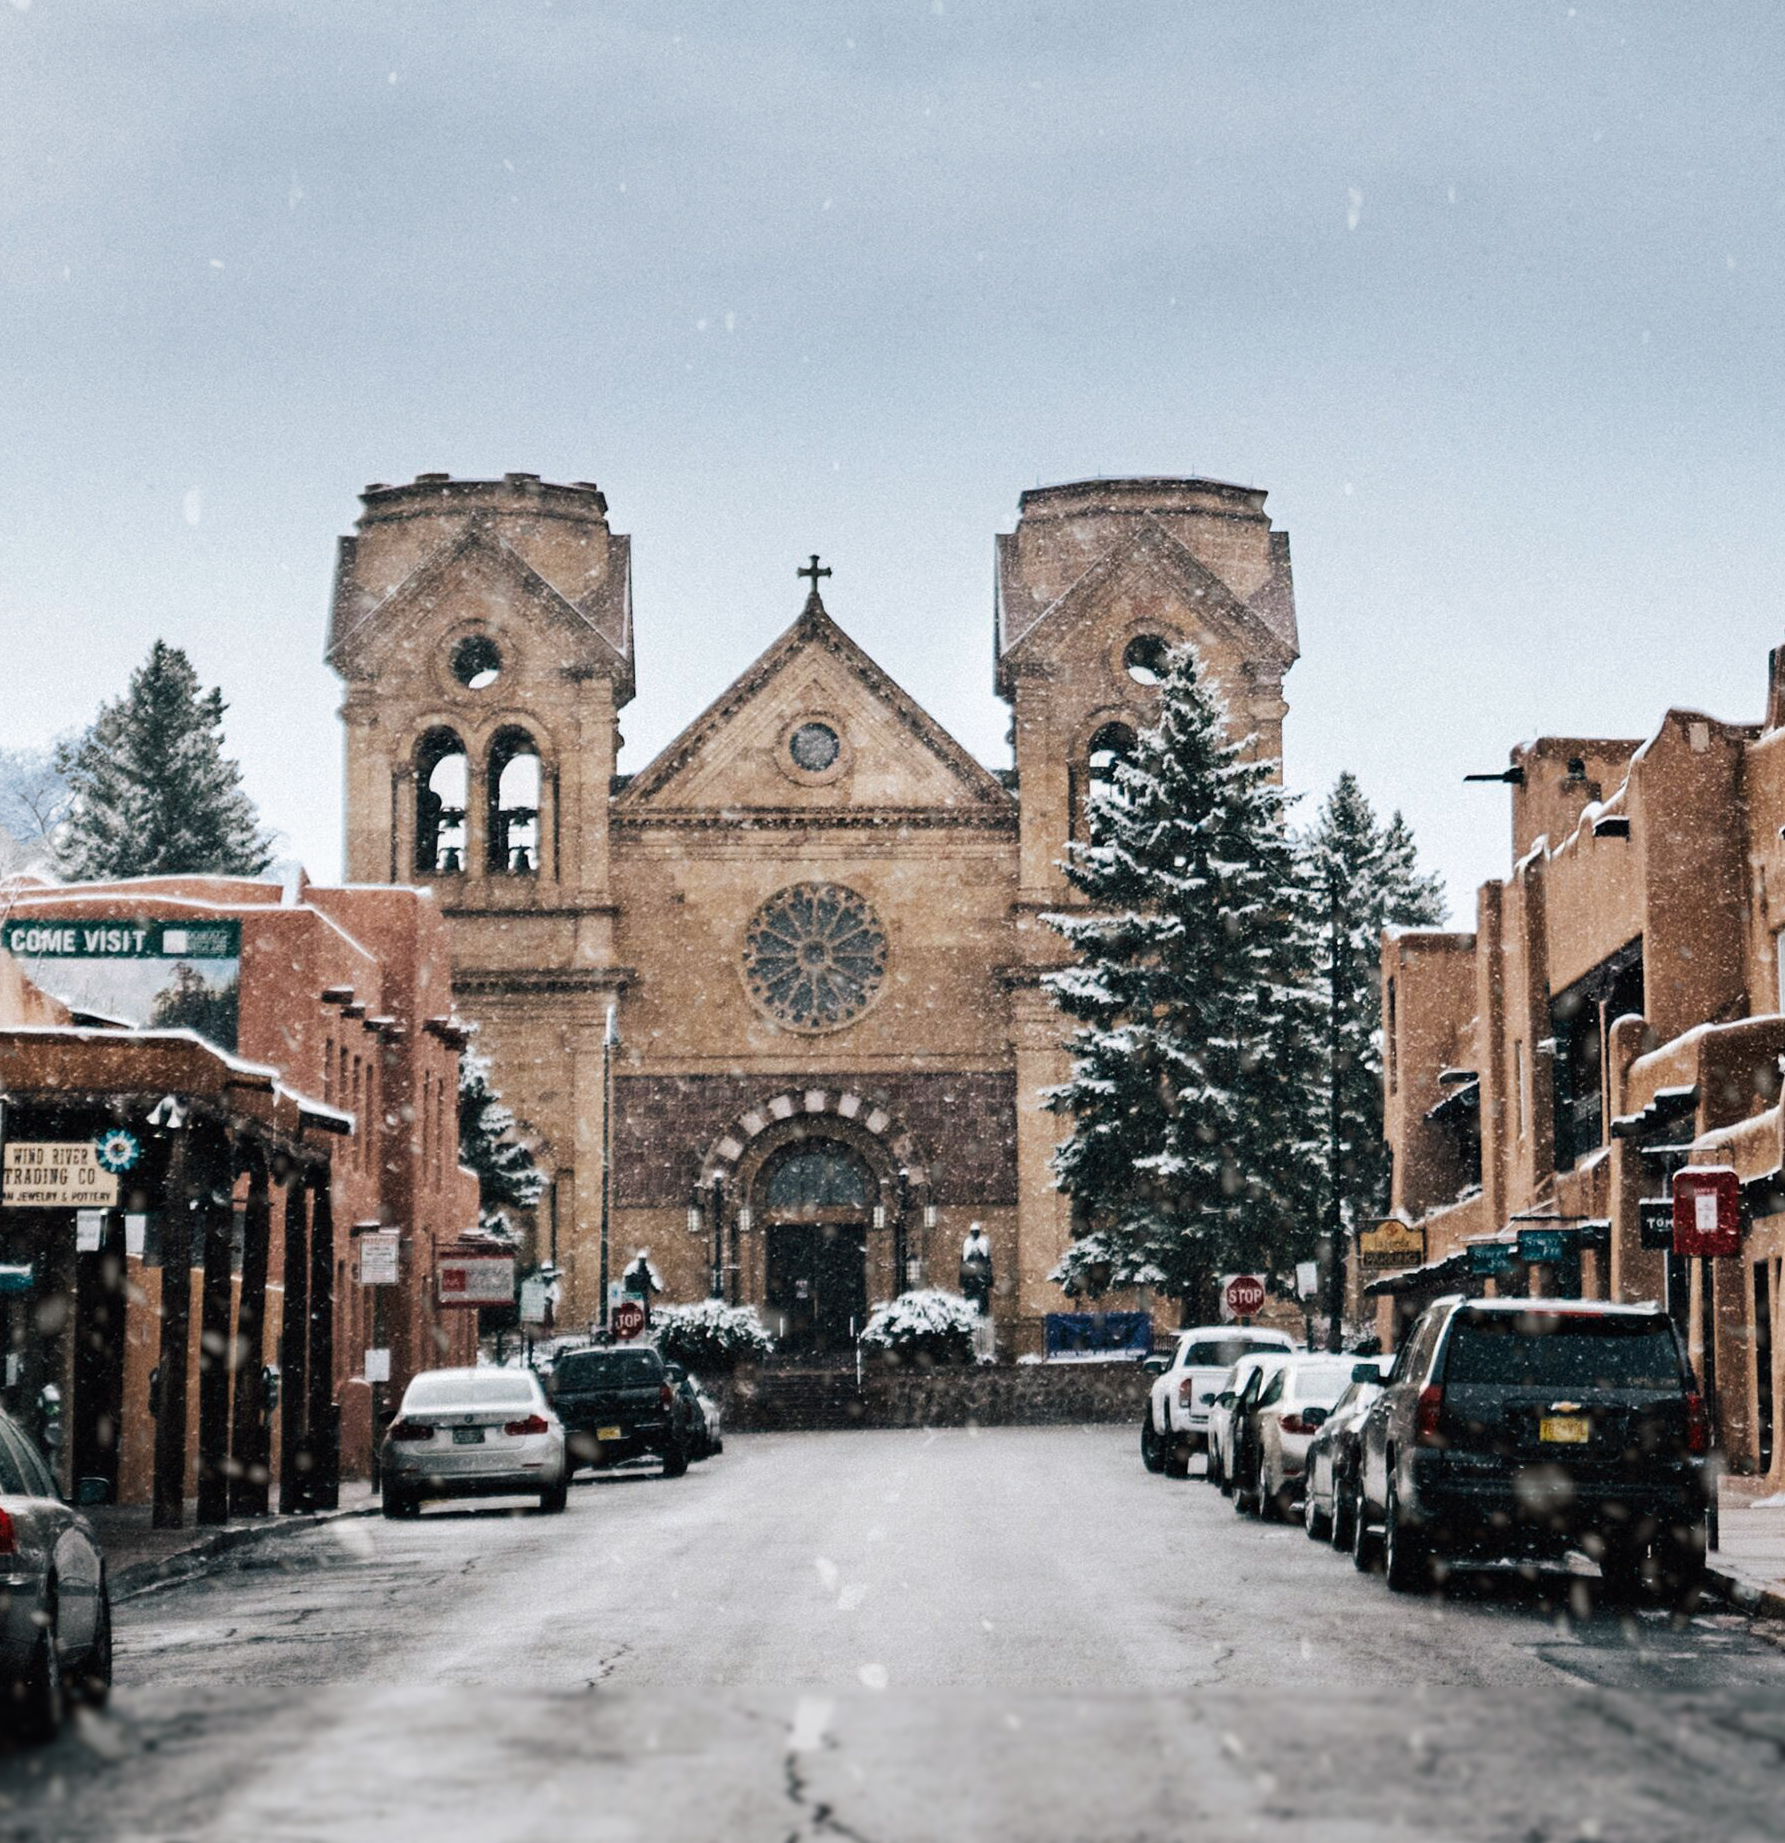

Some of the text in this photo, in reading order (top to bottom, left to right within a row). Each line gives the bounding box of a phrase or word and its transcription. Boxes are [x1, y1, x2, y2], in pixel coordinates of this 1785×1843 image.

[11, 929, 147, 952] COME VISIT
[13, 1147, 89, 1165] WIND RIVER
[4, 1167, 96, 1186] TRADING CO
[16, 1191, 57, 1201] JEWELRY
[71, 1191, 111, 1201] POTTERY
[1228, 1288, 1262, 1304] STOP
[616, 1313, 642, 1330] TOP
